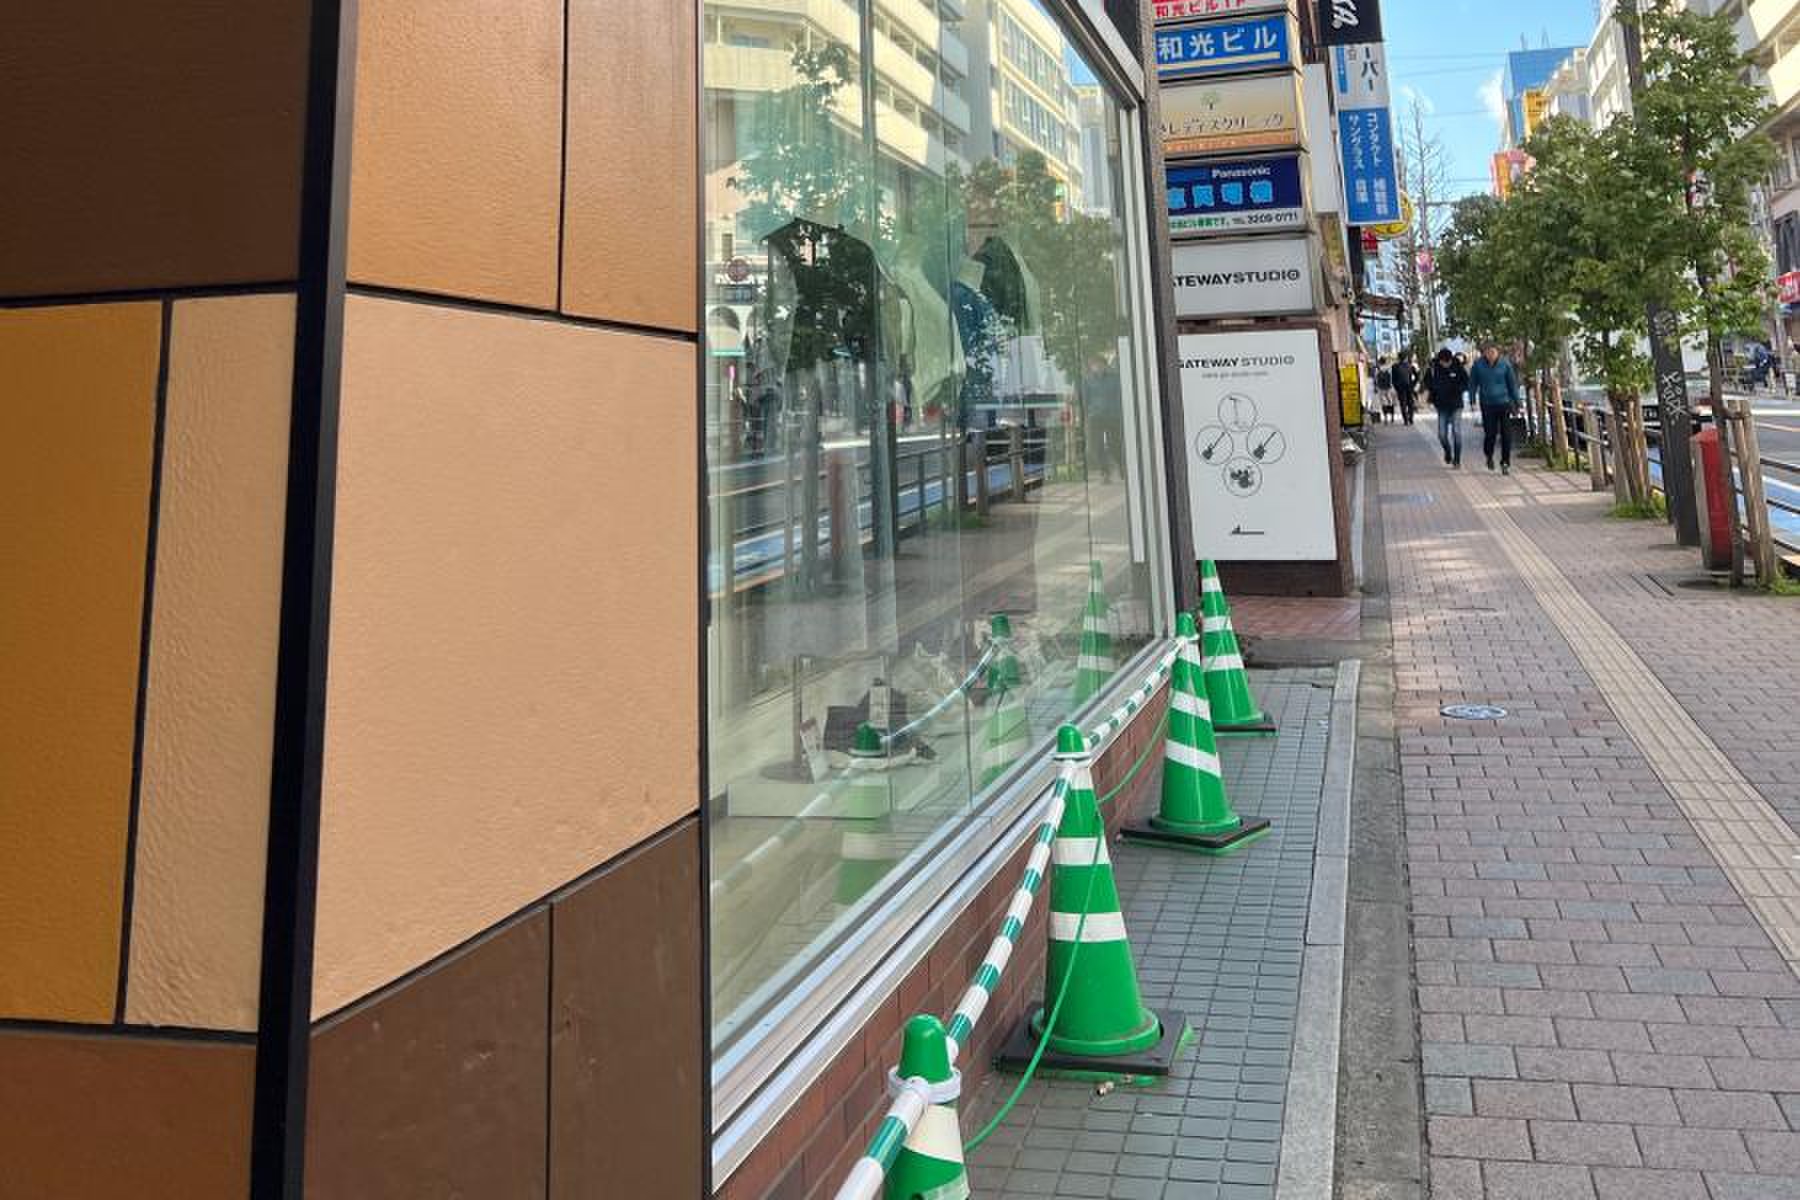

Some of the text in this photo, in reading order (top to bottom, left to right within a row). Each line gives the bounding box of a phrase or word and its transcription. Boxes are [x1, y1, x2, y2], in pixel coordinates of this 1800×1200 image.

[1157, 26, 1278, 61] 和光ビル
[1212, 164, 1271, 178] Panasonic
[1240, 355, 1295, 367] STUDIO
